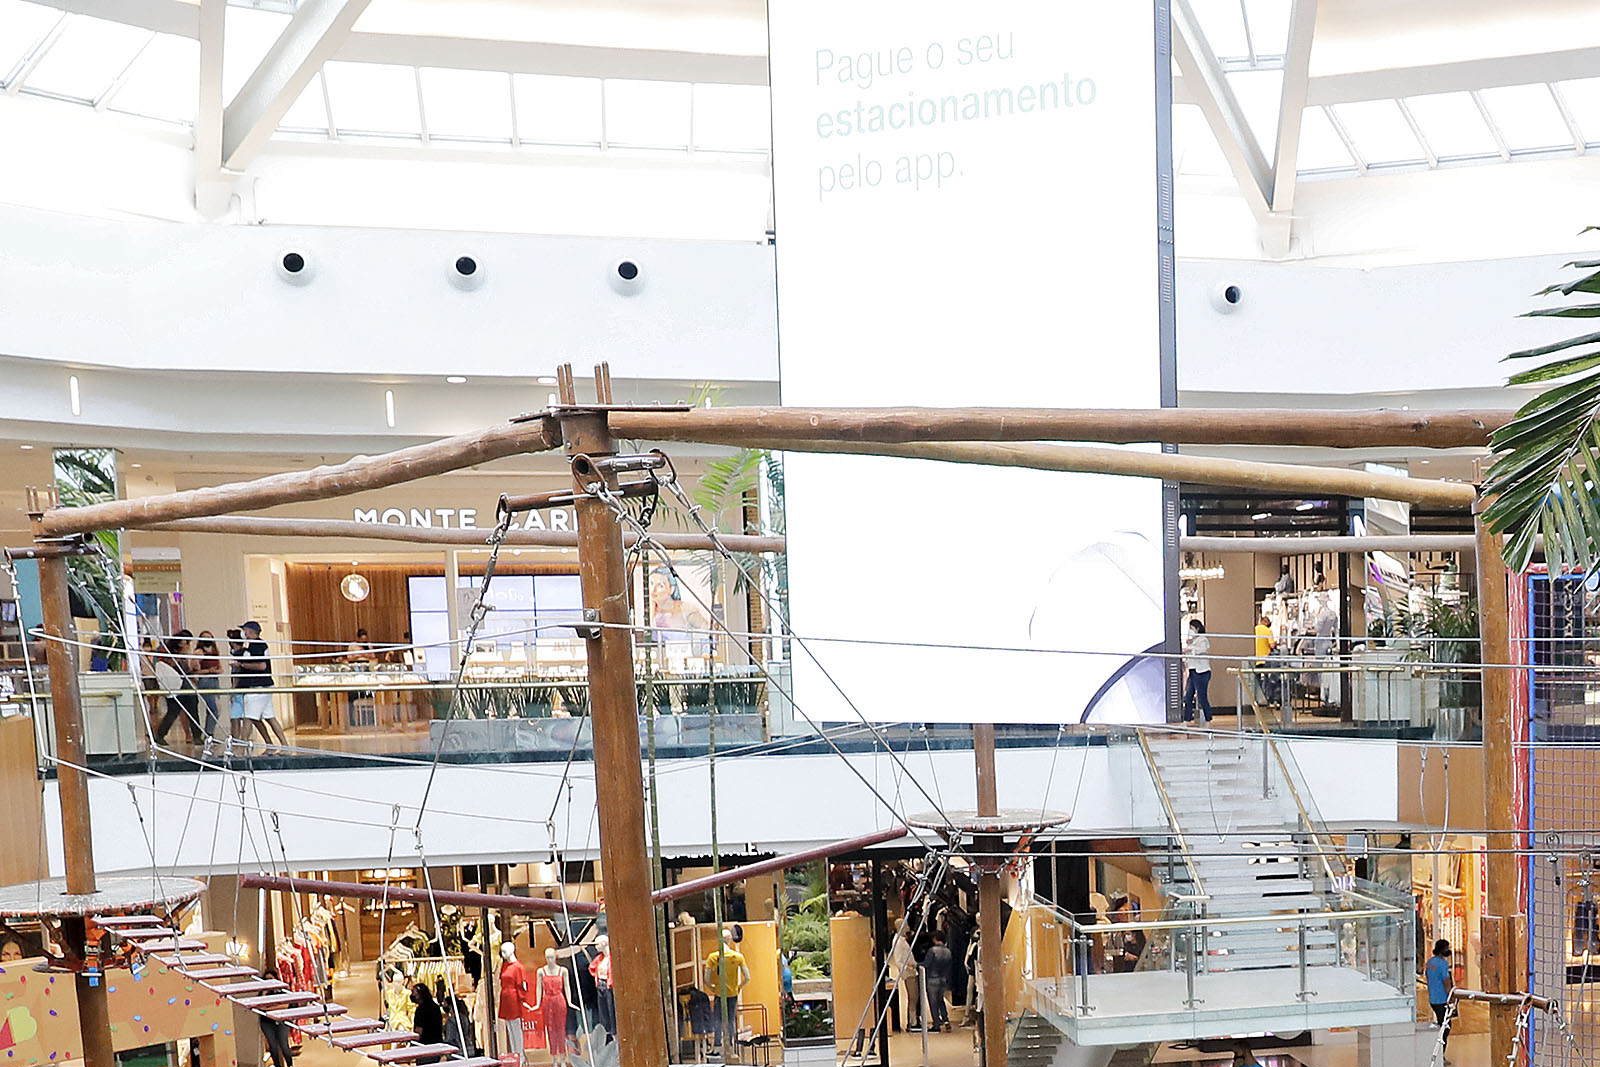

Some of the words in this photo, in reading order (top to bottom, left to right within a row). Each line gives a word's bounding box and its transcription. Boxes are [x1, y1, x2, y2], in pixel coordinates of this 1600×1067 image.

[815, 47, 914, 90] Pague
[926, 42, 944, 69] o
[956, 31, 1014, 66] seu
[816, 72, 1097, 139] estacionamento
[818, 151, 883, 203] pelo
[895, 151, 964, 192] app.
[353, 508, 477, 529] MONTE
[518, 917, 597, 948] TVZ
